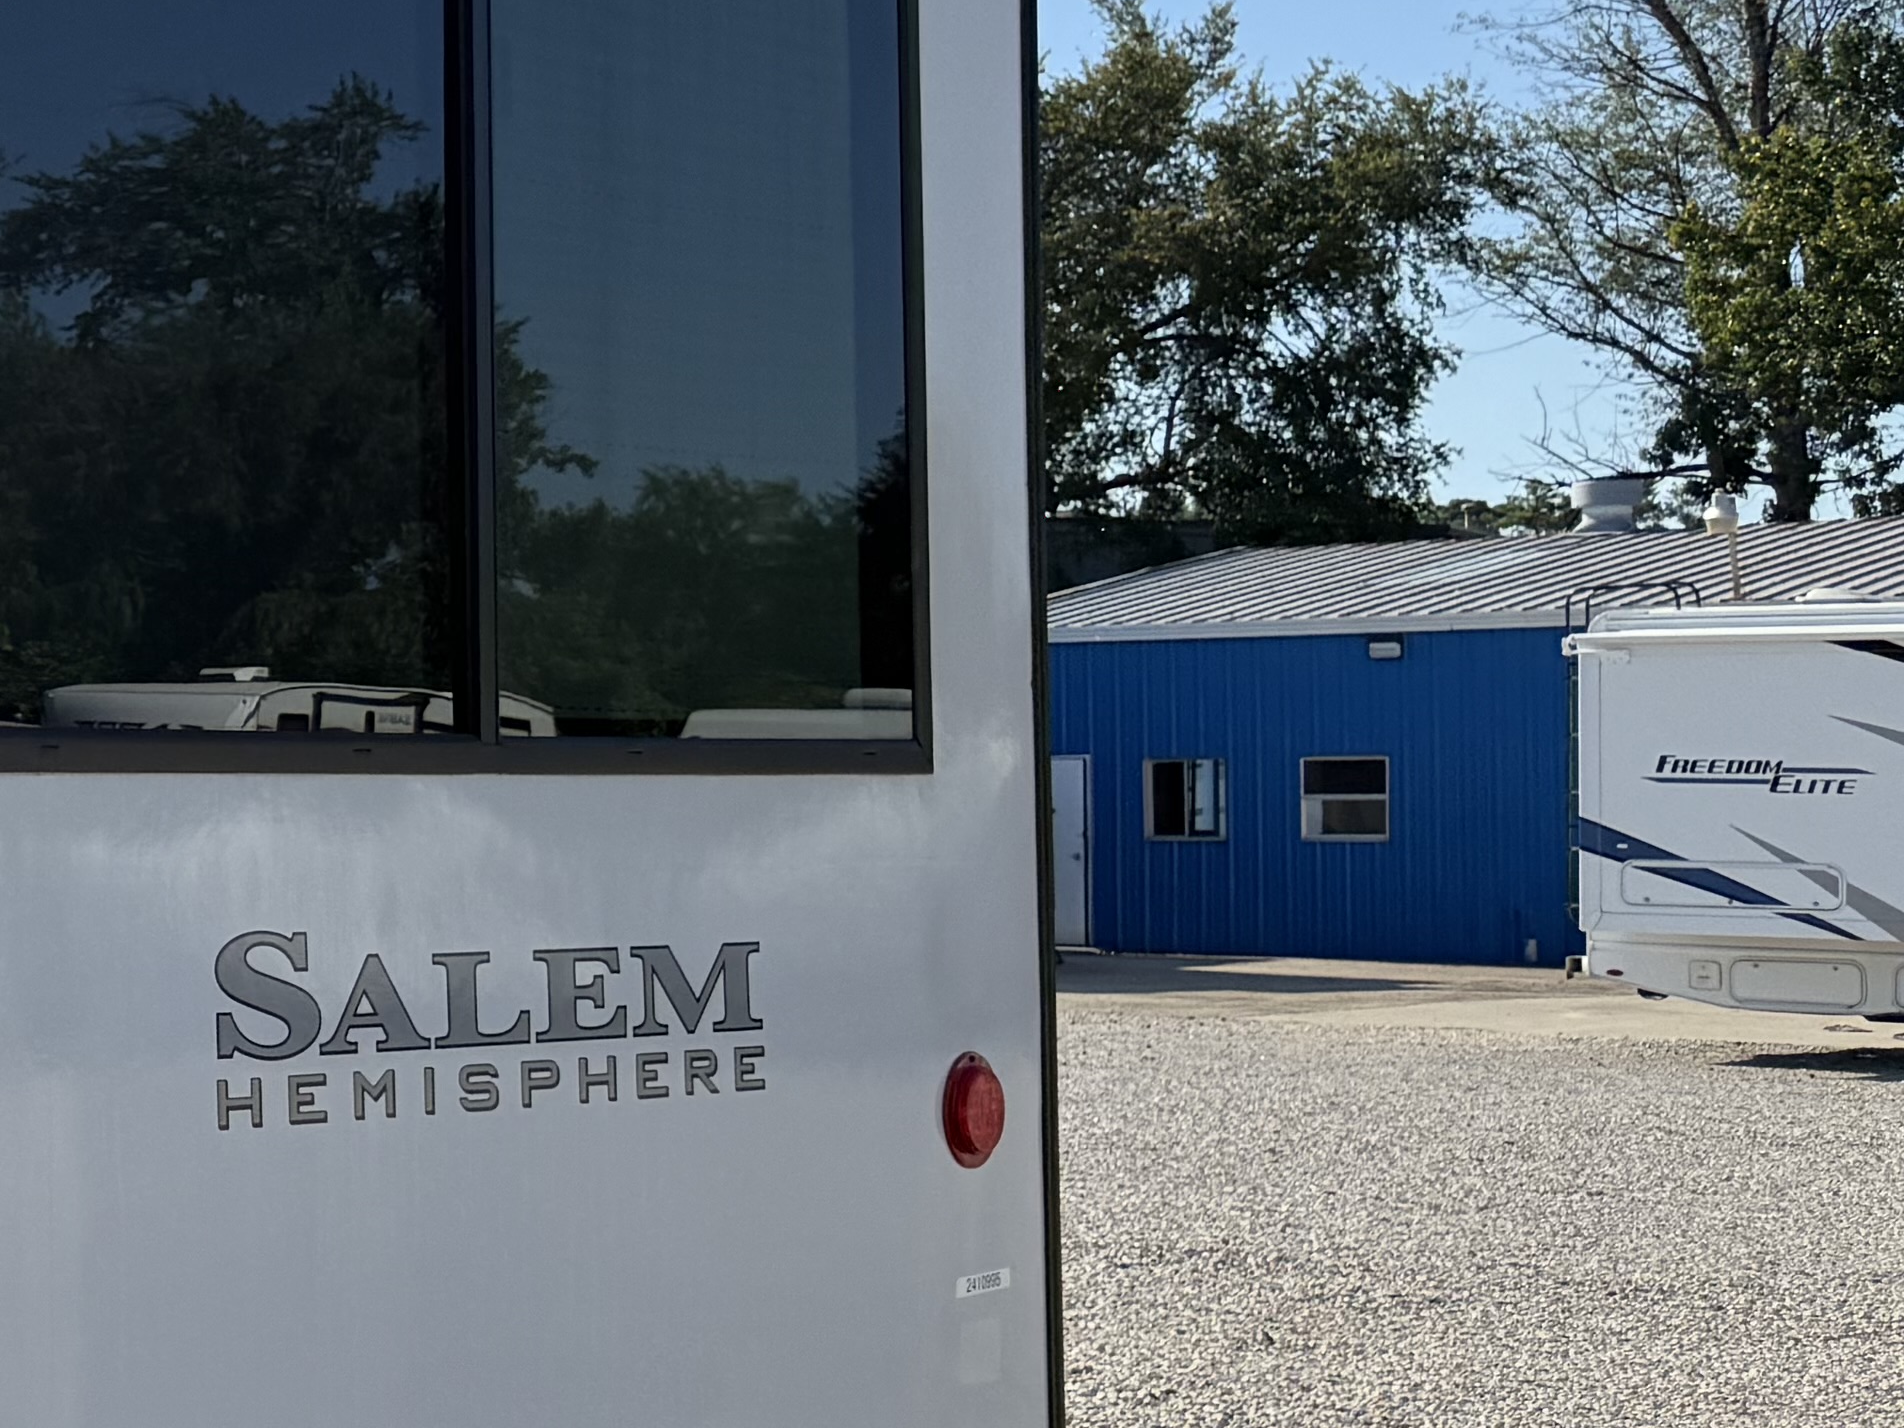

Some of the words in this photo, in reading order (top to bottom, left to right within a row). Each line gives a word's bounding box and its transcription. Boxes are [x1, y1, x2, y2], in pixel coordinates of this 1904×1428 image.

[1655, 755, 1784, 775] FREEDOM
[1769, 774, 1858, 795] ELITE
[214, 931, 764, 1060] SALEM
[217, 1046, 767, 1130] HEMISPHERE
